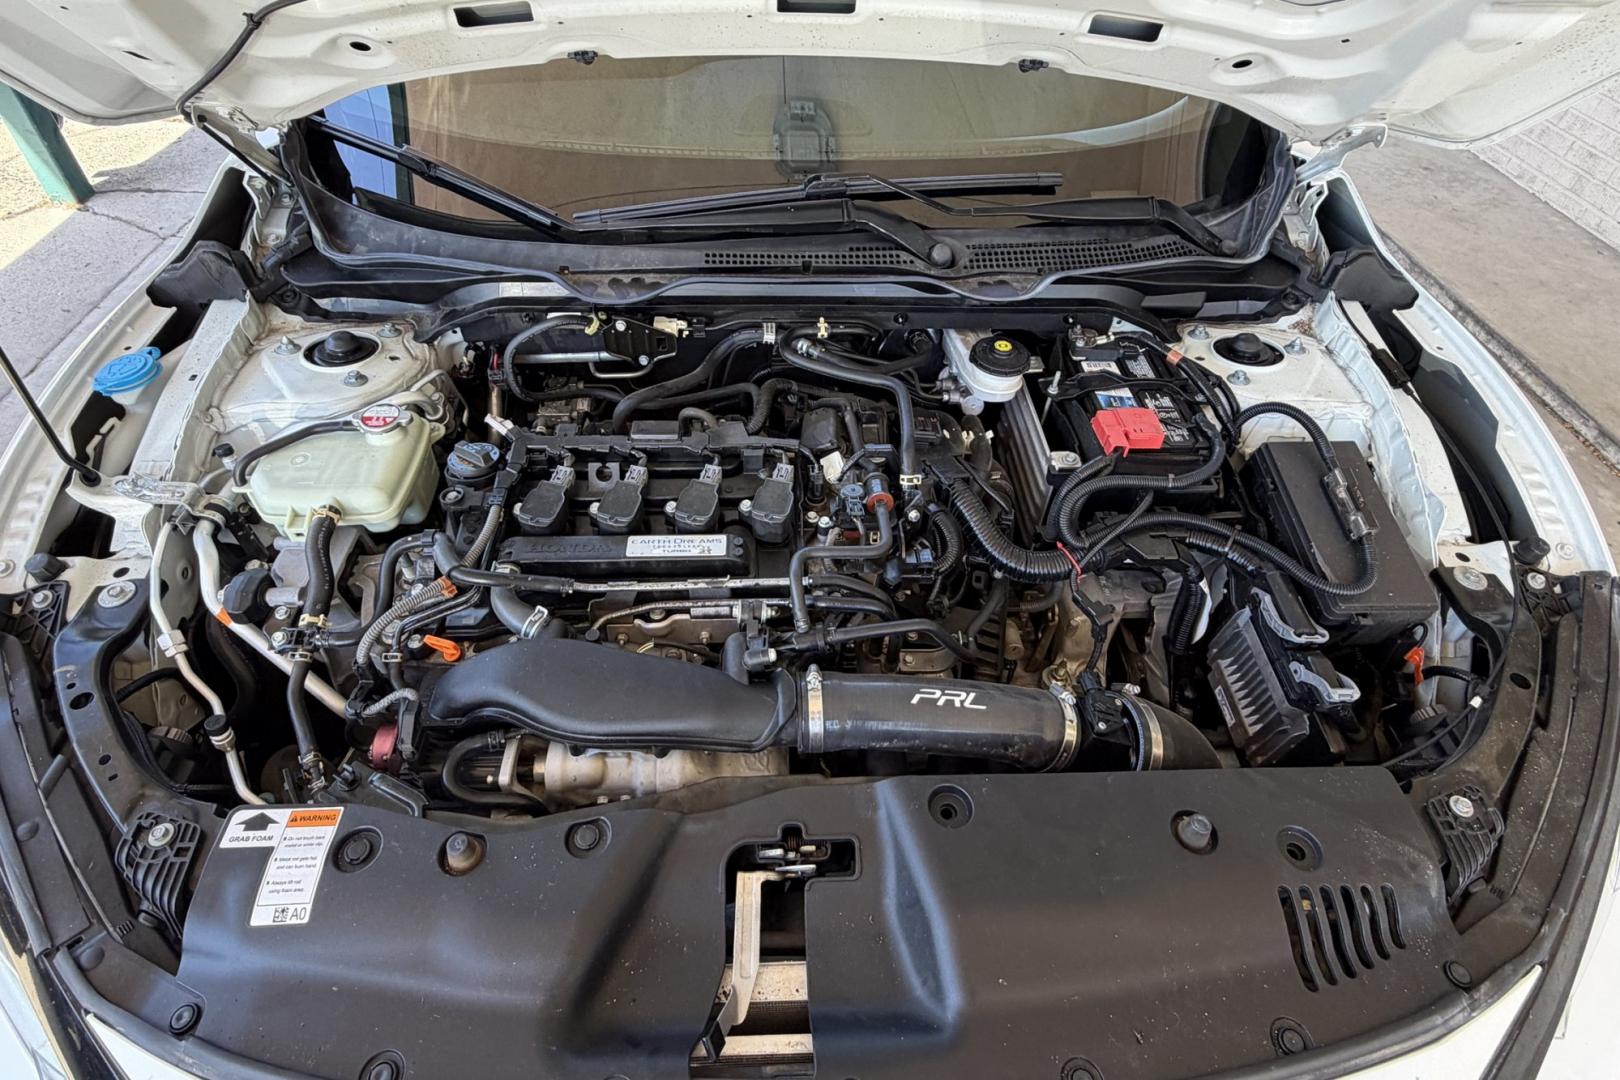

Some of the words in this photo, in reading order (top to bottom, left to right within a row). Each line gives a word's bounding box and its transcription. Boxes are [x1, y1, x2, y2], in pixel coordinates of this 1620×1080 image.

[910, 688, 988, 710] PRL
[299, 814, 337, 823] WARNING
[228, 835, 250, 843] GRAB
[289, 907, 307, 921] A0
